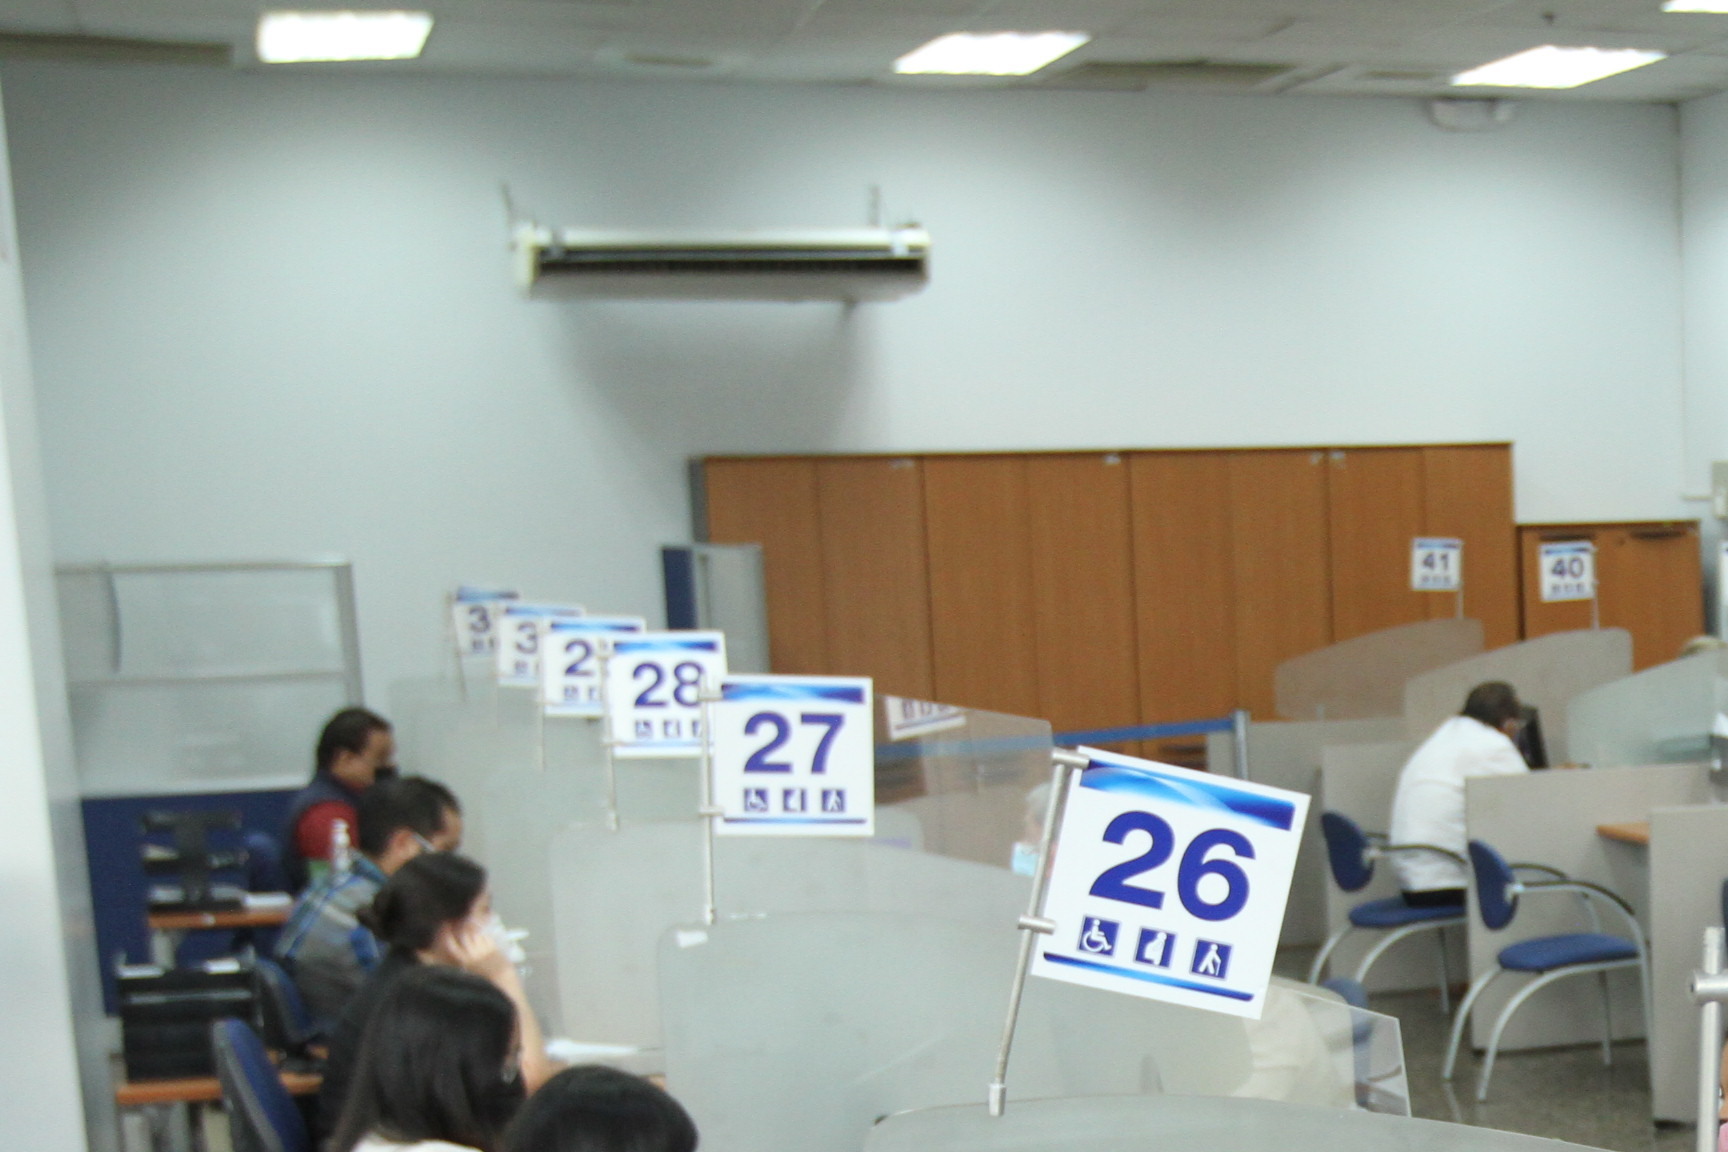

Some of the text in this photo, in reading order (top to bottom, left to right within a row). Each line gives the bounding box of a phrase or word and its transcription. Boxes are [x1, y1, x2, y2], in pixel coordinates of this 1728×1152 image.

[1422, 552, 1449, 571] 41
[1551, 556, 1584, 578] 40
[564, 638, 594, 676] 2
[632, 661, 705, 708] 28
[743, 710, 845, 774] 27
[1088, 810, 1256, 922] 26
